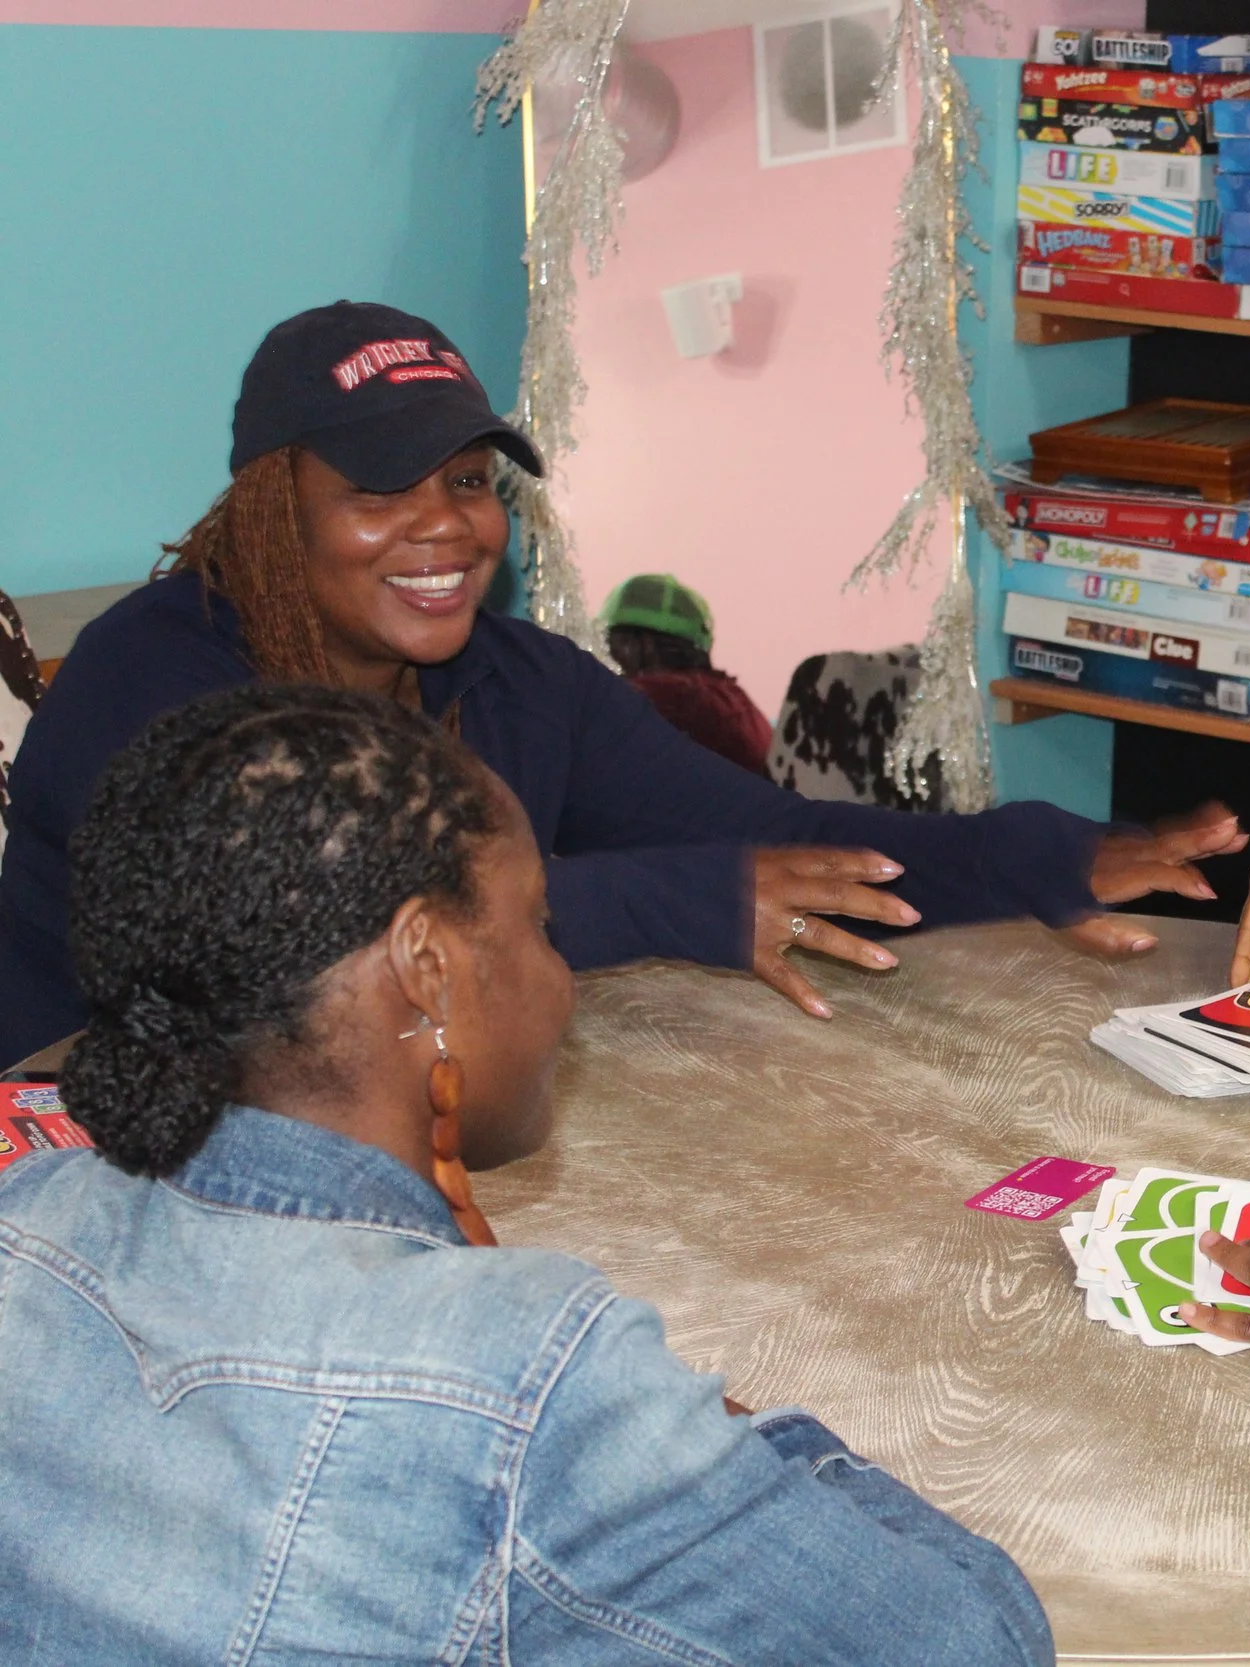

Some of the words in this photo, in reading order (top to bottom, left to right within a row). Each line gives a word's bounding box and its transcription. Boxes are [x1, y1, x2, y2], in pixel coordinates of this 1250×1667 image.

[1095, 40, 1169, 63] BATTLESHIP
[1055, 72, 1108, 90] Yahtzee
[1050, 151, 1115, 183] LIFE
[333, 338, 436, 392] WRIGLEY
[1037, 507, 1104, 525] MONOPOLY
[1086, 575, 1138, 604] LIFE
[1153, 637, 1194, 660] Clue
[1017, 649, 1081, 673] BATTLESHIP
